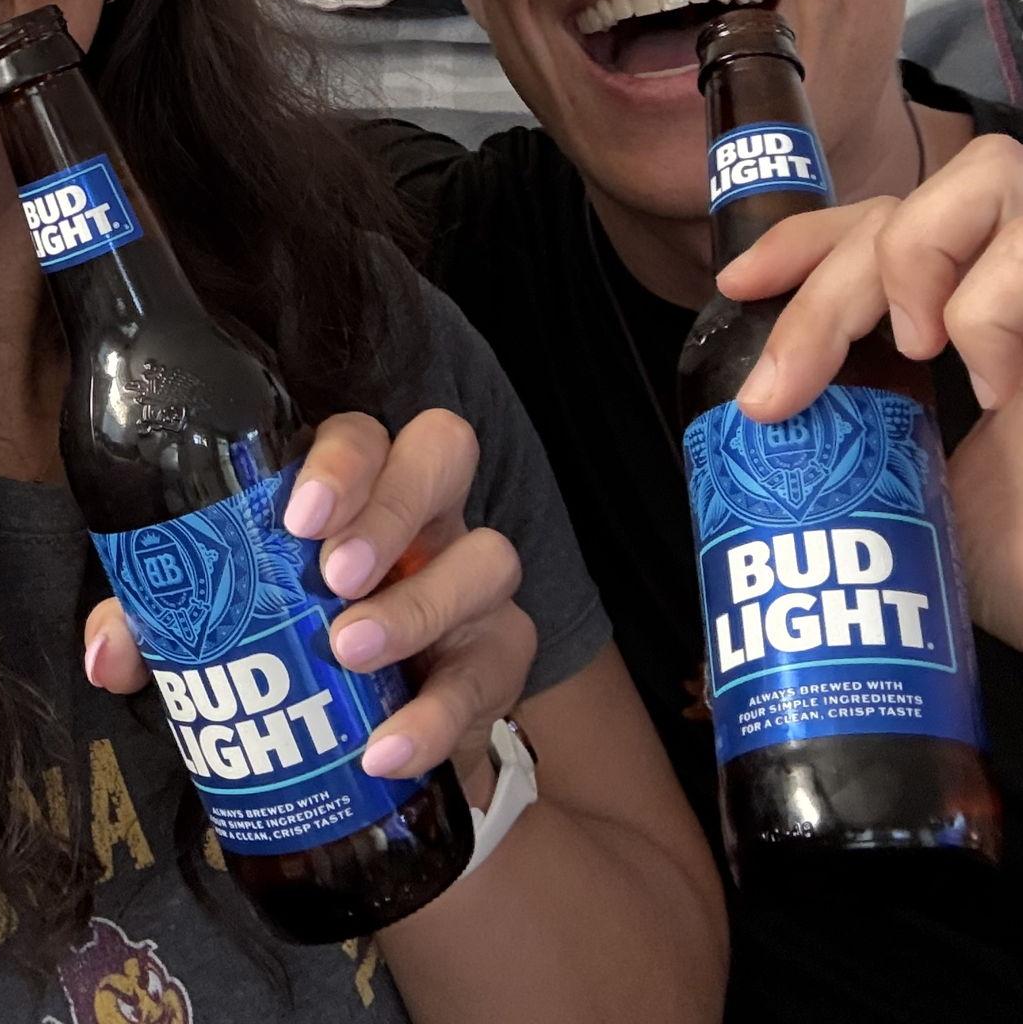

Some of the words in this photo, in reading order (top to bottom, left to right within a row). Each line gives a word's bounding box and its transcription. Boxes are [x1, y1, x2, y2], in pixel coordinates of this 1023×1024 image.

[716, 133, 793, 171] BUD
[710, 155, 812, 202] LIGHT
[22, 185, 87, 230] BUD
[30, 202, 113, 258] IGHT
[727, 528, 894, 605] BUD
[715, 589, 930, 674] LIGHT
[152, 652, 291, 723] BUD
[749, 687, 796, 707] ALWAYS
[799, 681, 863, 695] BREWED
[866, 680, 903, 691] WITH
[738, 707, 766, 724] FOUR
[769, 697, 819, 714] SIMPLE
[823, 694, 924, 705] INGREDIENTS
[741, 721, 761, 736] FOR
[764, 719, 773, 728] A
[775, 711, 824, 726] CLEAN,
[828, 707, 875, 719] CRISP
[878, 706, 923, 719] TASTE
[212, 807, 244, 819] ALWAYS
[245, 803, 295, 819] BREWED
[296, 790, 330, 808] WITH
[228, 820, 265, 830] SIMPLE
[266, 795, 351, 828] INGREDIENTS
[229, 831, 236, 840] A
[236, 830, 273, 842] CLEAN,
[273, 824, 312, 840] CRISP
[313, 807, 354, 829] TASTE
